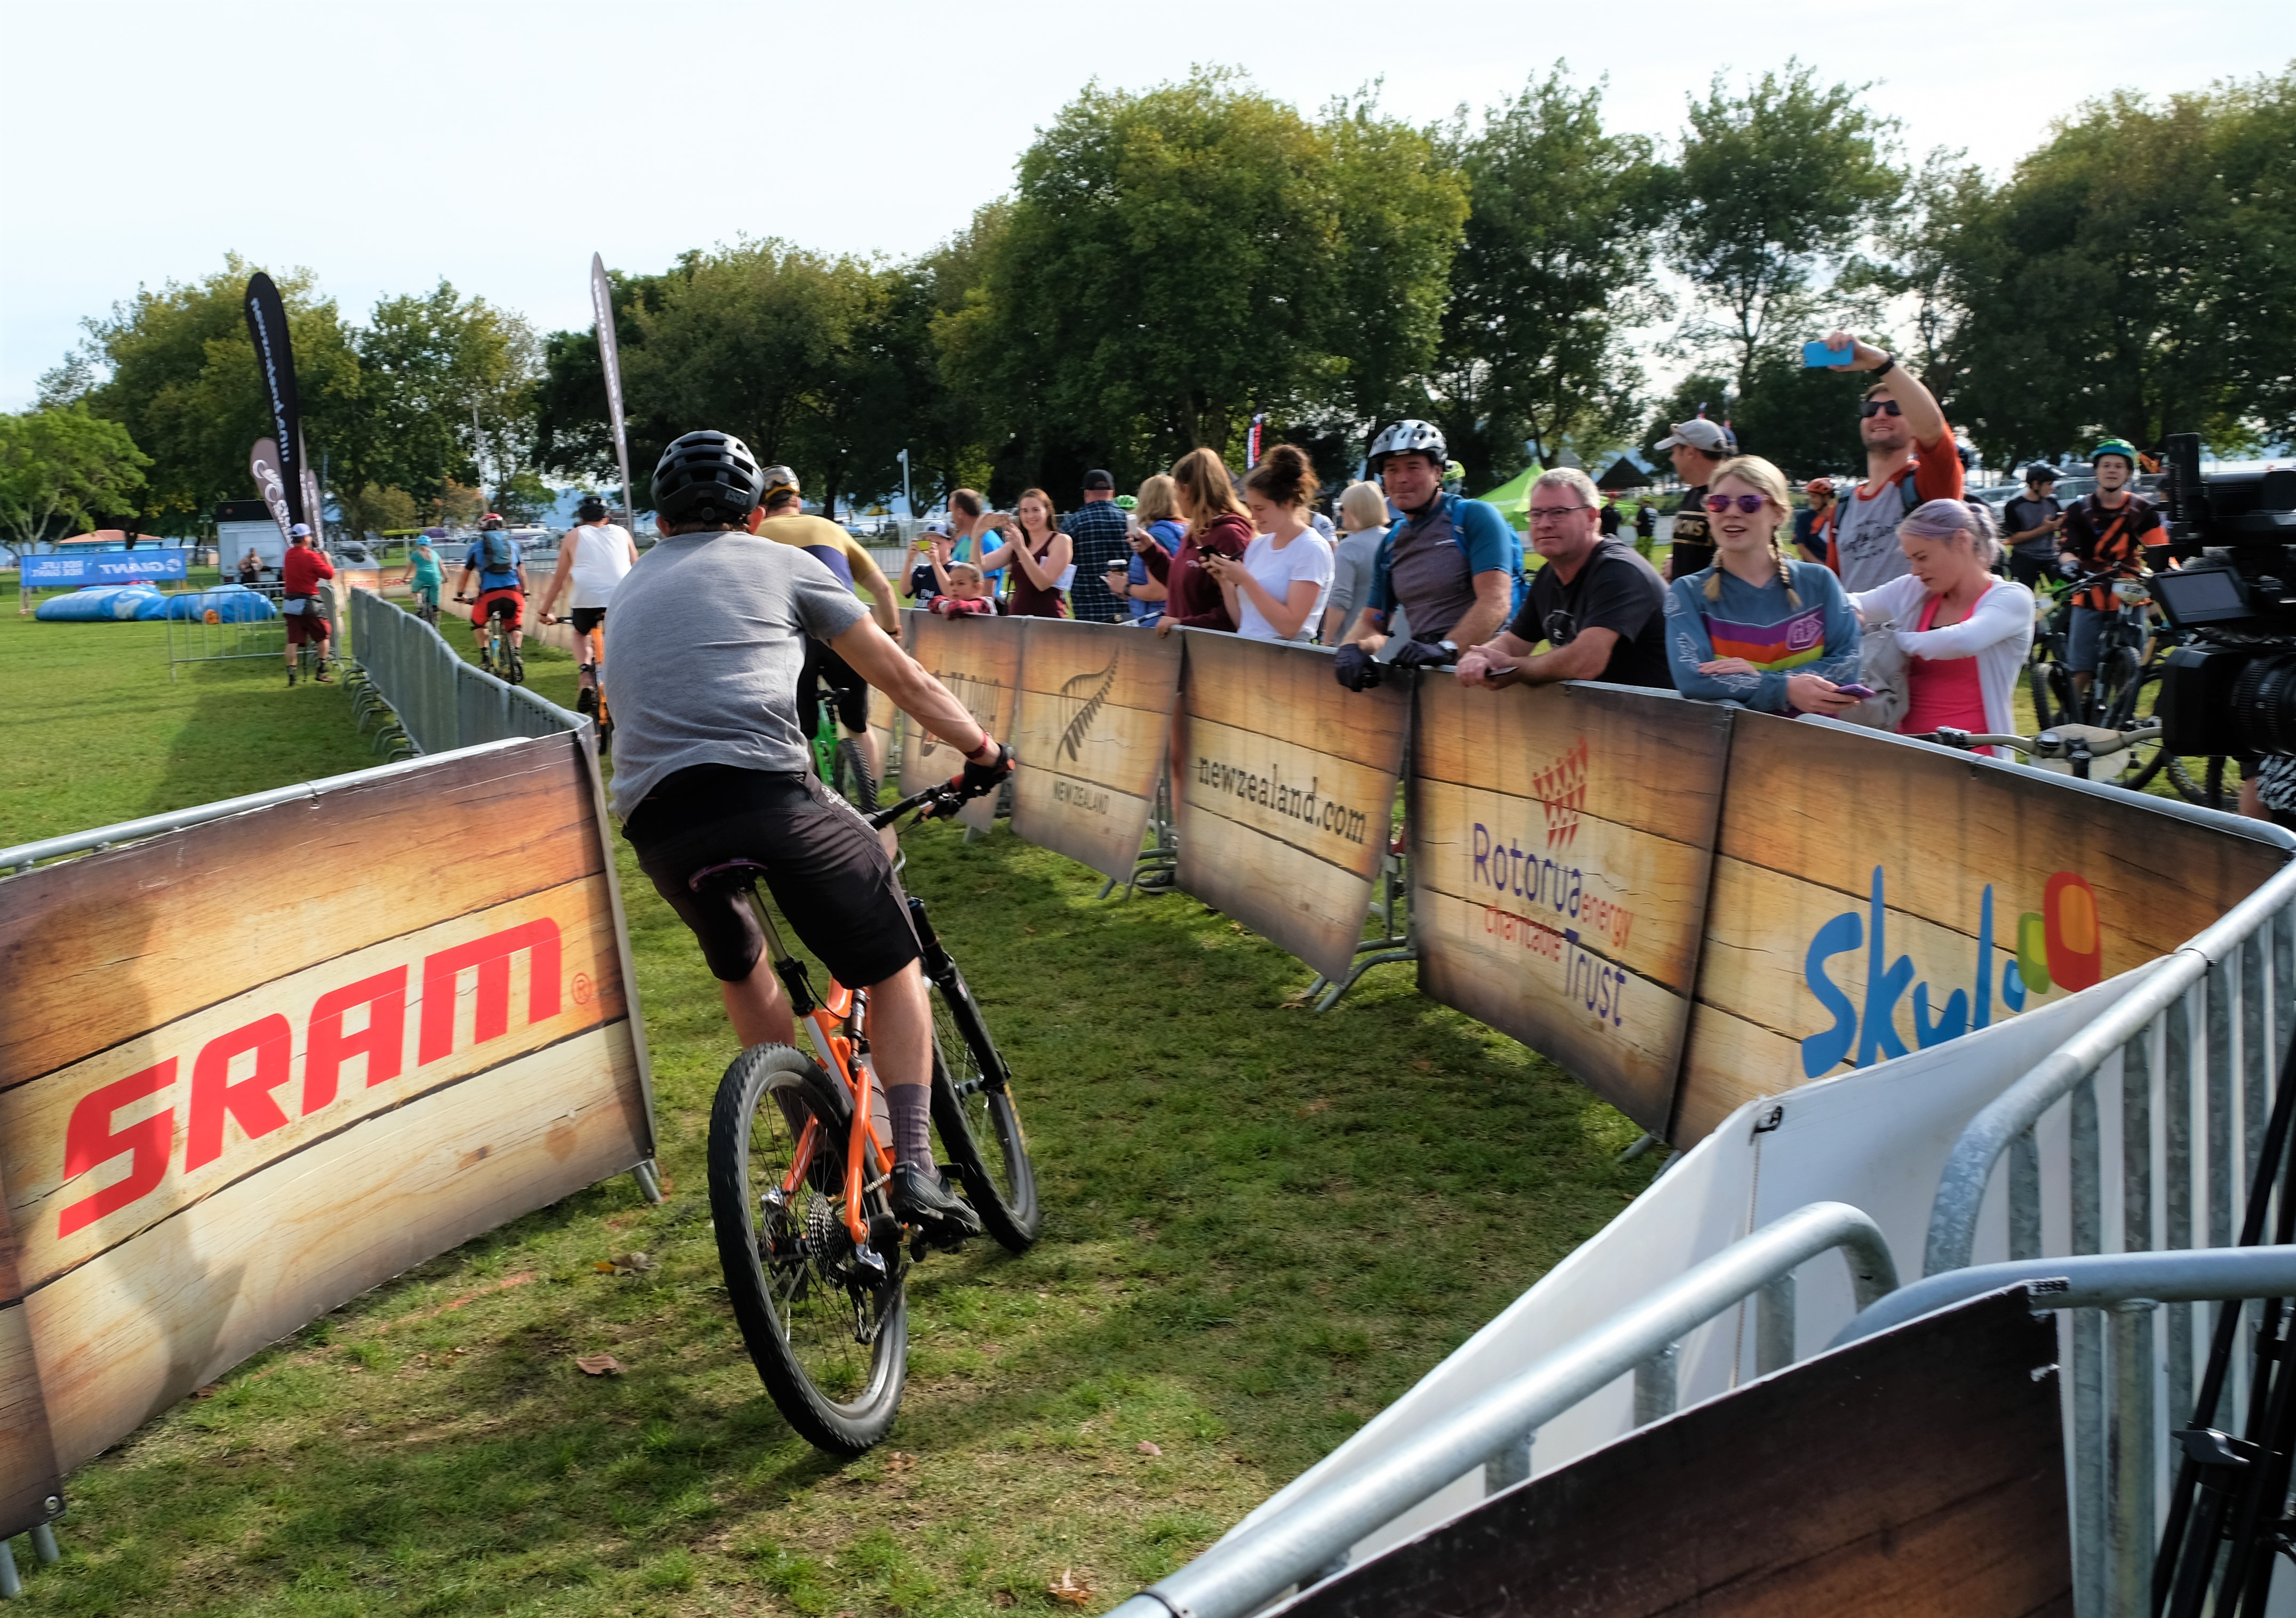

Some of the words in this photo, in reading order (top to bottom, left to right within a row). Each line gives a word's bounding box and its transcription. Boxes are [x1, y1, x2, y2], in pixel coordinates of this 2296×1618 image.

[1053, 780, 1073, 802] NEW
[1072, 785, 1110, 815] ZEALAND
[1198, 757, 1367, 845] newzealand.com
[1473, 822, 1582, 918] Rotorua
[1564, 927, 1626, 1027] Trust
[57, 917, 561, 1240] SRAM
